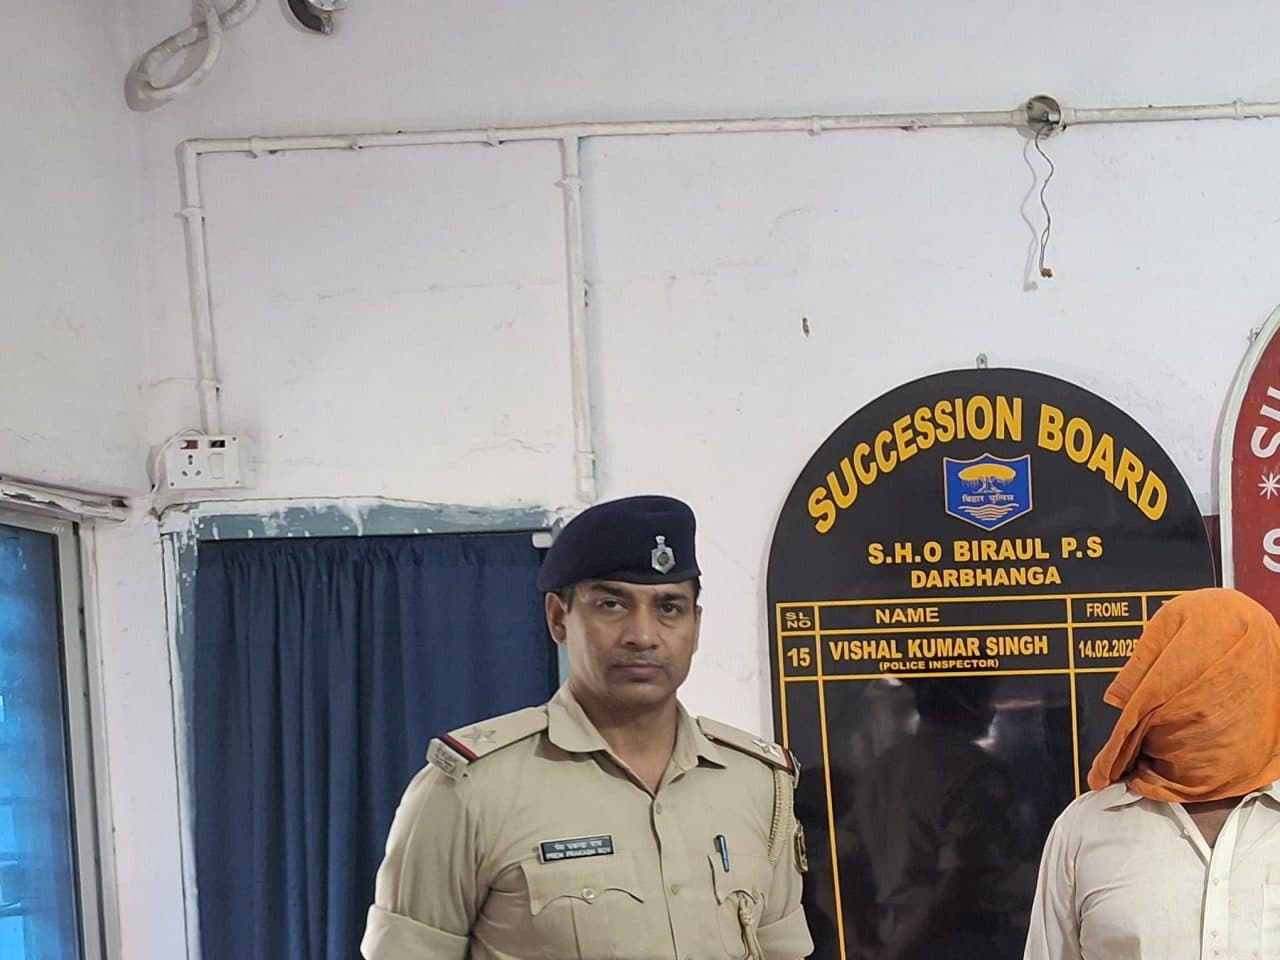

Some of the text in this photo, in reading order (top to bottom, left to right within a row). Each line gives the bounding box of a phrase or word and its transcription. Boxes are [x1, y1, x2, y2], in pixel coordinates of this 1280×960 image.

[807, 395, 1168, 534] SUCCESSION BOARD
[867, 536, 1103, 565] S.H.O BIRAUL P.S
[910, 566, 1061, 589] DARBHANGA
[875, 607, 940, 624] NAME
[1086, 602, 1130, 617] FROME
[787, 620, 812, 628] NO
[787, 647, 811, 667] 15
[828, 635, 1048, 660] VISHAL KUMAR SINGH
[879, 658, 999, 672] (POLICE INSPECTOR)
